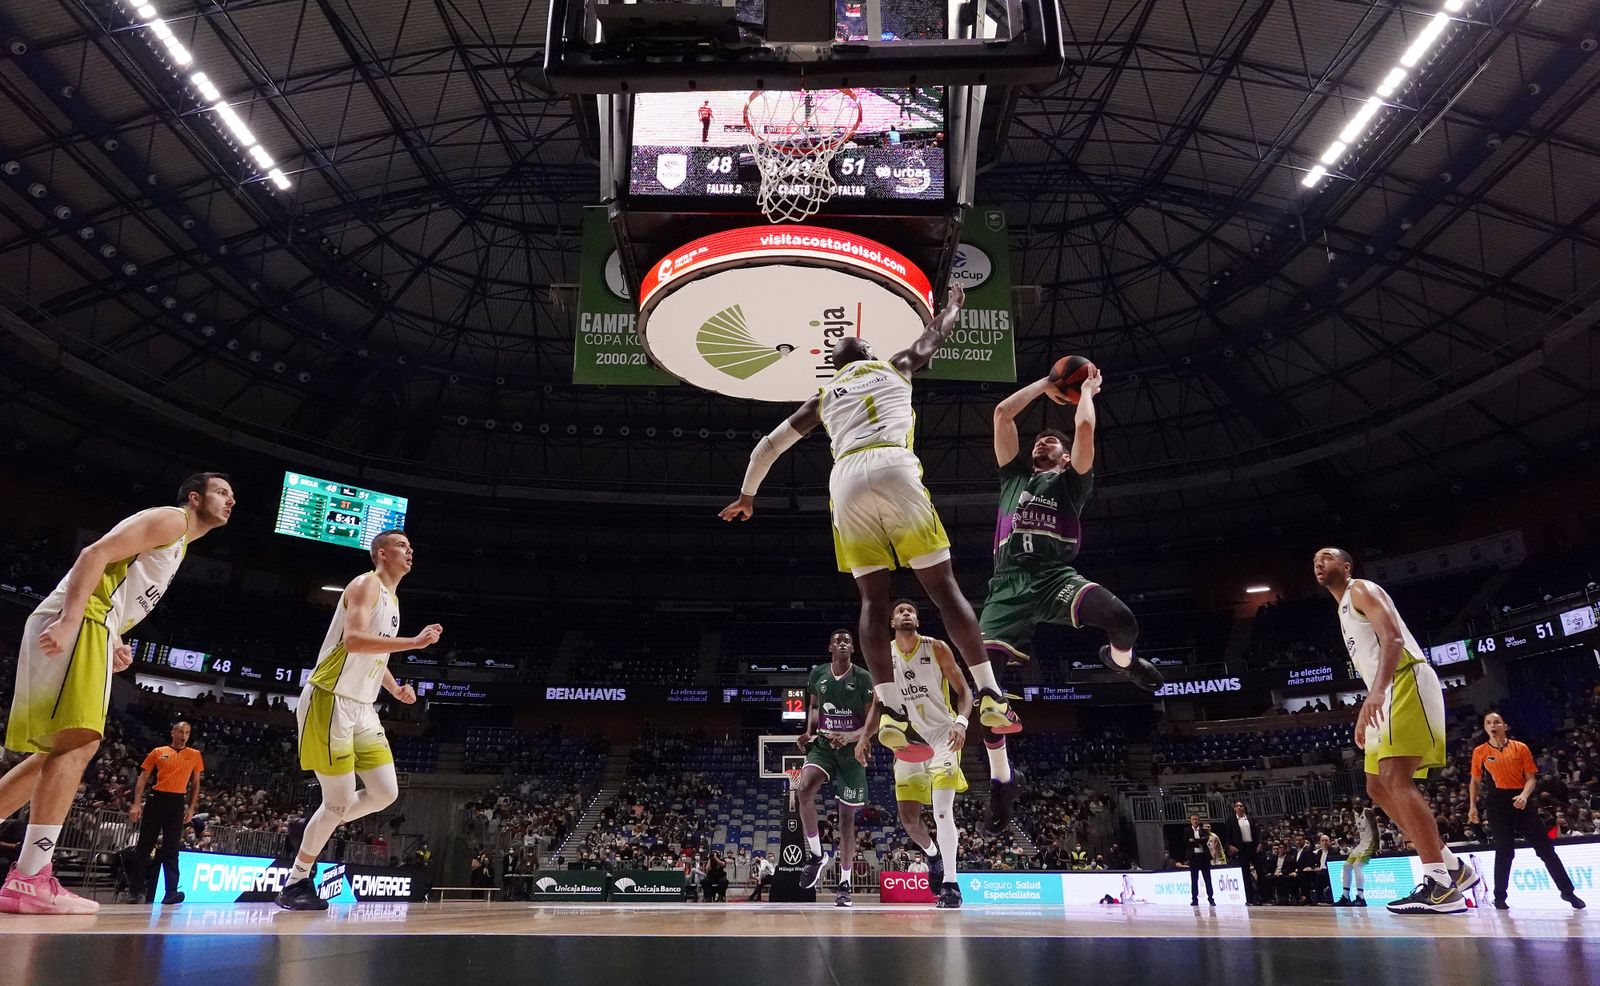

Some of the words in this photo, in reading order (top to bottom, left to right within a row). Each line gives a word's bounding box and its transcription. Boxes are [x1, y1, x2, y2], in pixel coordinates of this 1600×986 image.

[706, 156, 732, 174] 48
[841, 158, 865, 175] 51
[707, 184, 735, 194] FALTAS
[735, 184, 742, 194] 2
[838, 185, 865, 196] FALTAS
[759, 234, 907, 276] visitacostadelsol.com
[951, 270, 983, 281] roCup
[580, 312, 636, 334] CAMPE
[953, 309, 1010, 331] PEONES
[584, 333, 622, 346] COPA
[625, 333, 641, 346] KO
[944, 330, 1004, 345] ROCUP
[596, 353, 648, 365] 2000/20
[325, 484, 337, 493] 48
[358, 491, 369, 500] 51
[335, 513, 356, 525] 5:41
[328, 525, 336, 534] 2
[1022, 533, 1034, 553] 8
[1535, 622, 1554, 639] 51
[1477, 638, 1496, 653] 48
[212, 658, 232, 673] 48
[1289, 670, 1299, 678] La
[1300, 665, 1332, 677] elección
[275, 668, 292, 682] 51
[1305, 673, 1333, 684] natural
[546, 687, 627, 701] BENAHAVIS
[788, 690, 803, 698] 5:41
[786, 699, 803, 712] 12
[916, 703, 926, 721] 7
[192, 862, 293, 893] POWERAD
[883, 874, 930, 890] ende
[1373, 870, 1395, 883] Salud
[1512, 868, 1550, 891] CON
[1568, 866, 1593, 889] UY
[351, 874, 412, 897] POWERADE
[555, 884, 581, 893] Unicaja
[634, 884, 660, 894] Unicaja
[660, 885, 681, 893] Banco
[983, 880, 1012, 891] Seguro
[1016, 879, 1041, 889] Salud
[983, 890, 1041, 901] Especialistas
